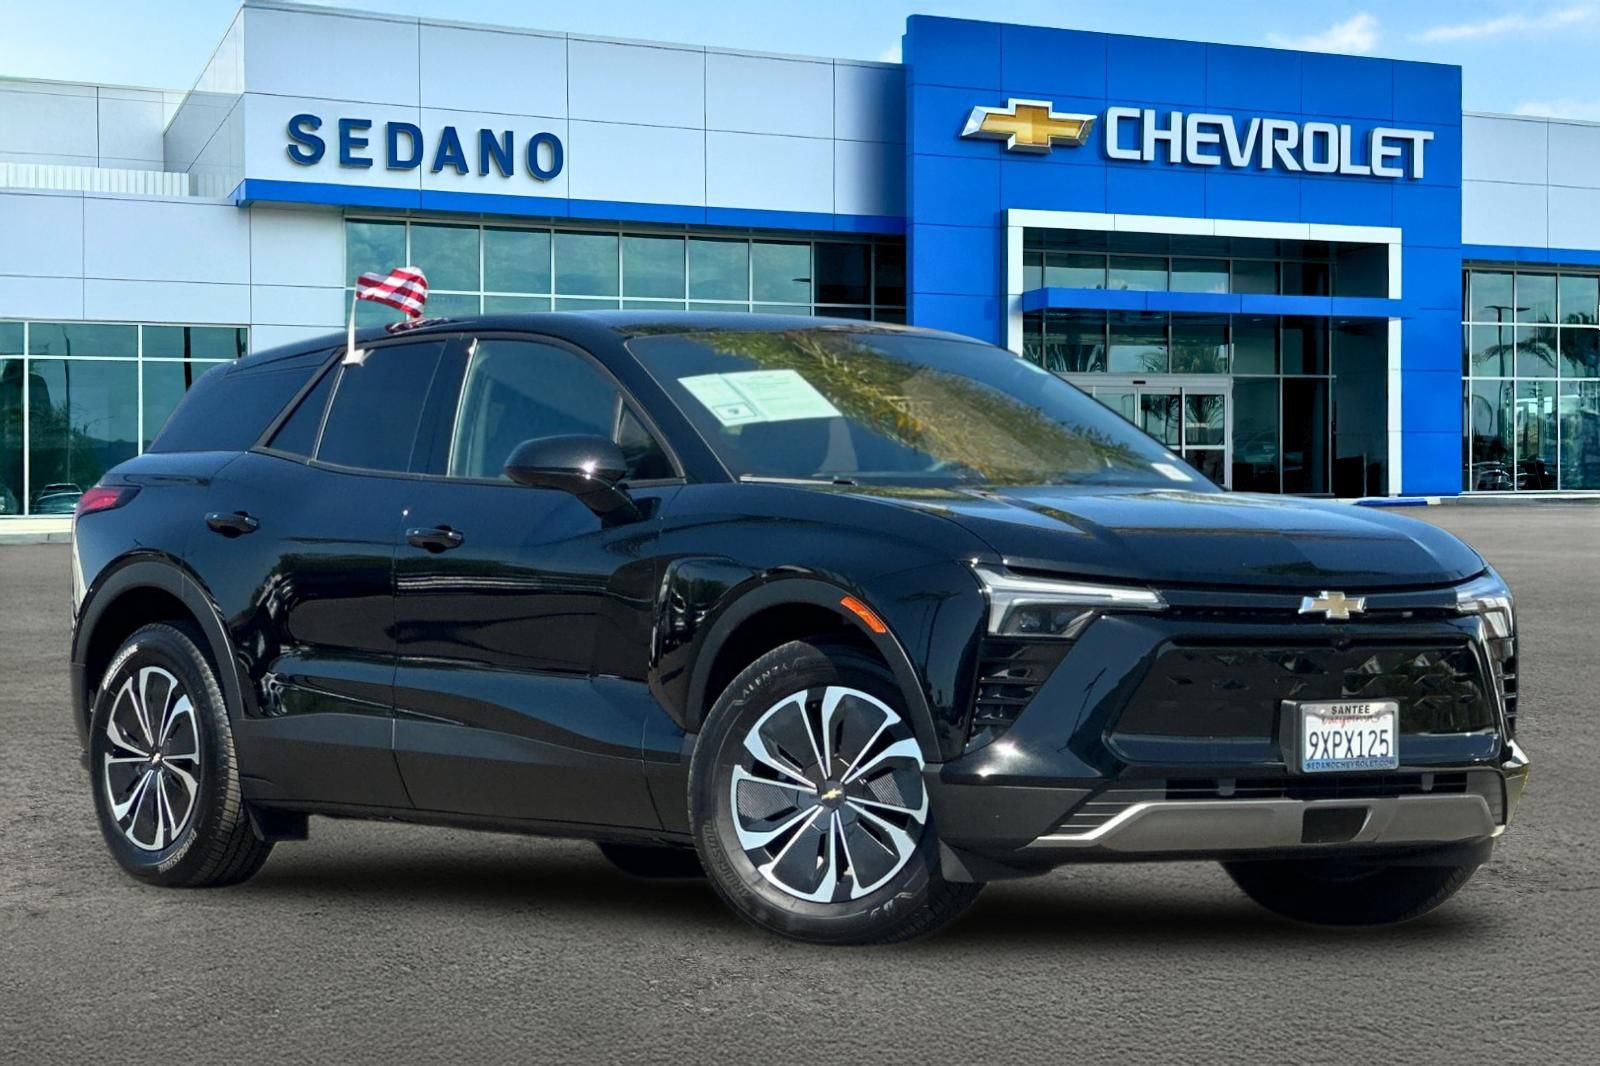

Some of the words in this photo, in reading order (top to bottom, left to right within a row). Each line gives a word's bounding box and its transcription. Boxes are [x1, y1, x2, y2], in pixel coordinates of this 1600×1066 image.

[287, 113, 564, 182] SEDANO
[1106, 106, 1435, 179] CHEVROLET
[1331, 704, 1371, 715] SANTEE
[1309, 729, 1390, 760] 9XPX125
